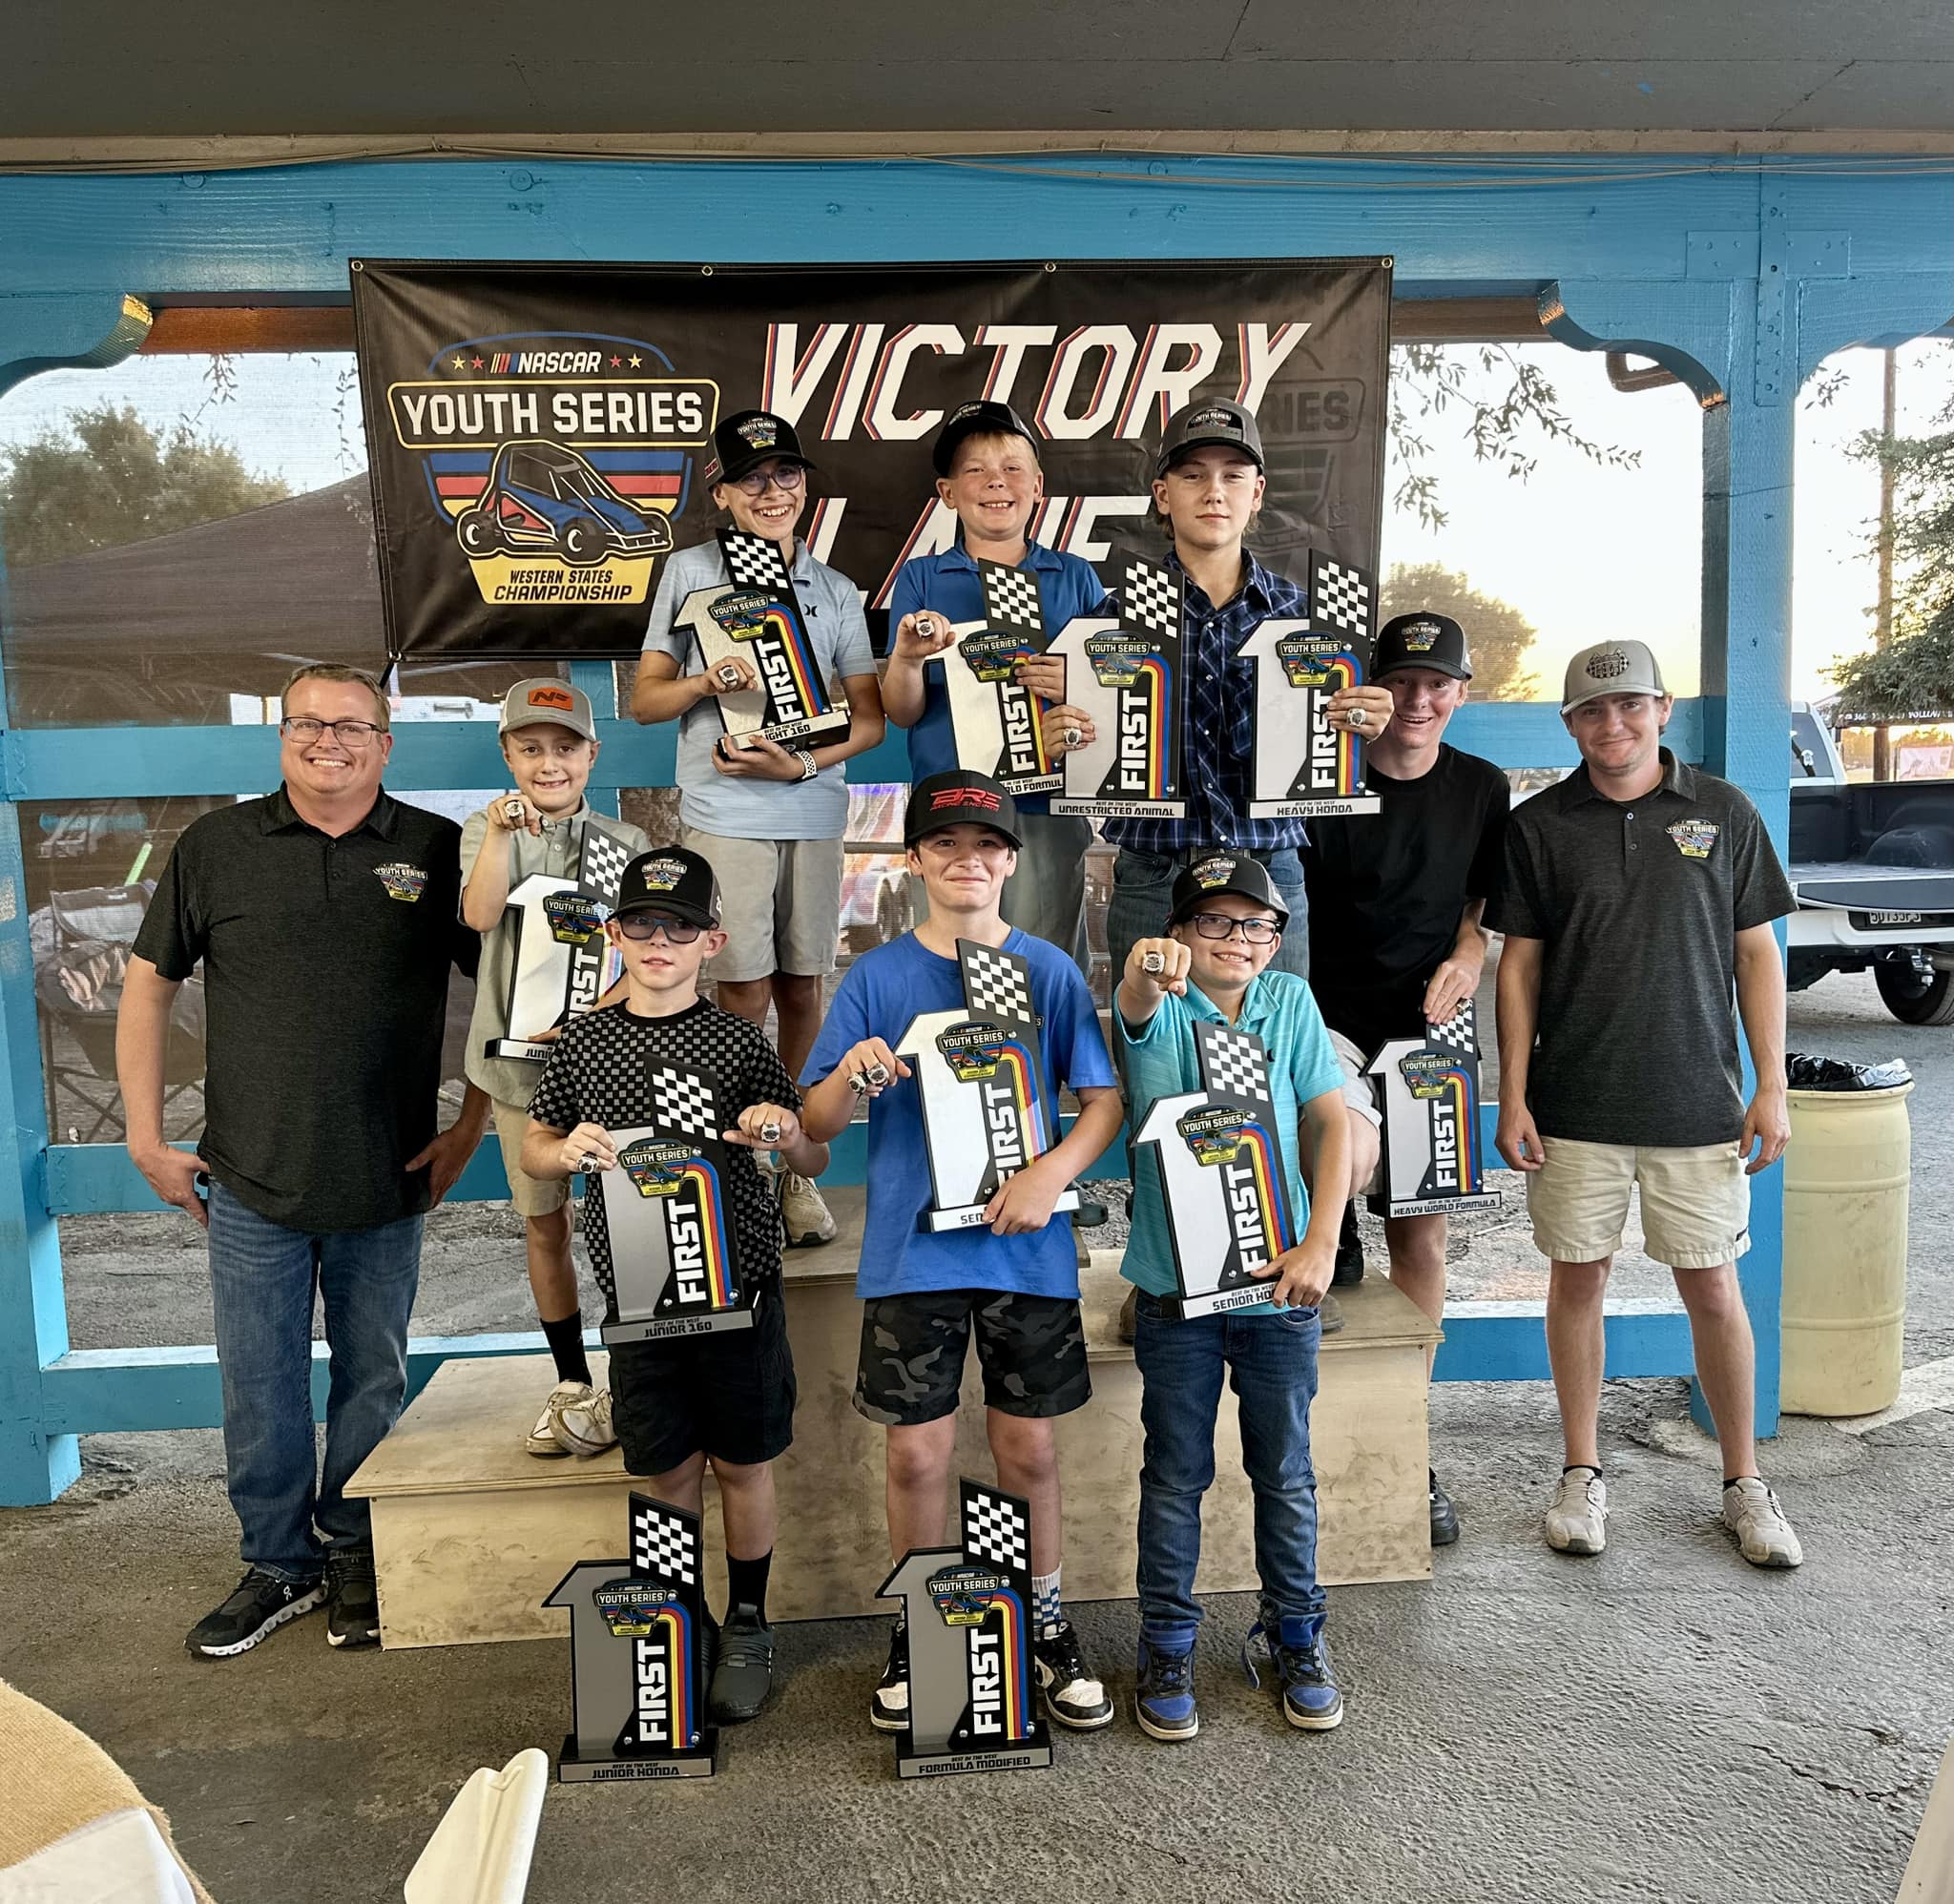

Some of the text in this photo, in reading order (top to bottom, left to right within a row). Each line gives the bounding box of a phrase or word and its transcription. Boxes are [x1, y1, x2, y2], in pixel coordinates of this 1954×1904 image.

[517, 352, 602, 373] NASCAR
[761, 322, 1313, 441] VICTORY
[402, 391, 704, 435] YOUTH SERIES
[509, 569, 613, 584] WESTERN STATES
[493, 585, 633, 602] CHAMPIONSHIP
[714, 599, 766, 616] YOUTH SERIES
[965, 639, 1017, 654] YOUTH SERIES
[1090, 644, 1147, 652] YOUTH SERIES
[1283, 643, 1339, 653] YOUTH SERIES
[756, 639, 803, 723] FIRST
[791, 724, 811, 735] 160
[1002, 681, 1035, 773] FIRST
[1121, 690, 1148, 791] FIRST
[1311, 689, 1337, 789] FIRST
[1024, 779, 1063, 792] FORMUL
[1058, 805, 1174, 817] UNRESTRICTED ANIMAL
[1277, 804, 1353, 817] HEAVY HONDA
[549, 900, 574, 912] YOUTH
[943, 1031, 1004, 1048] YOUTH SERIES
[1405, 1059, 1451, 1070] YOUTH SERIES
[1184, 1114, 1242, 1132] YOUTH SERIES
[1433, 1099, 1457, 1189] FIRST
[624, 1149, 688, 1164] YOUTH SERIES
[1394, 1207, 1424, 1216] HEAVY
[1424, 1203, 1454, 1213] WORLD
[1455, 1199, 1496, 1211] FORMULA
[1226, 1165, 1268, 1273] FIRST
[669, 1198, 707, 1304] FIRST
[1212, 1294, 1255, 1312] SENIOR
[644, 1321, 713, 1338] JUNIOR 160
[932, 1579, 995, 1593] YOUTH SERIES
[599, 1592, 664, 1604] YOUTH SERIES
[969, 1628, 1003, 1735] FIRST
[637, 1639, 668, 1742] FIRST
[592, 1766, 680, 1779] JUNIOR HONDA
[919, 1756, 1031, 1774] FORMULA MODIFIED
